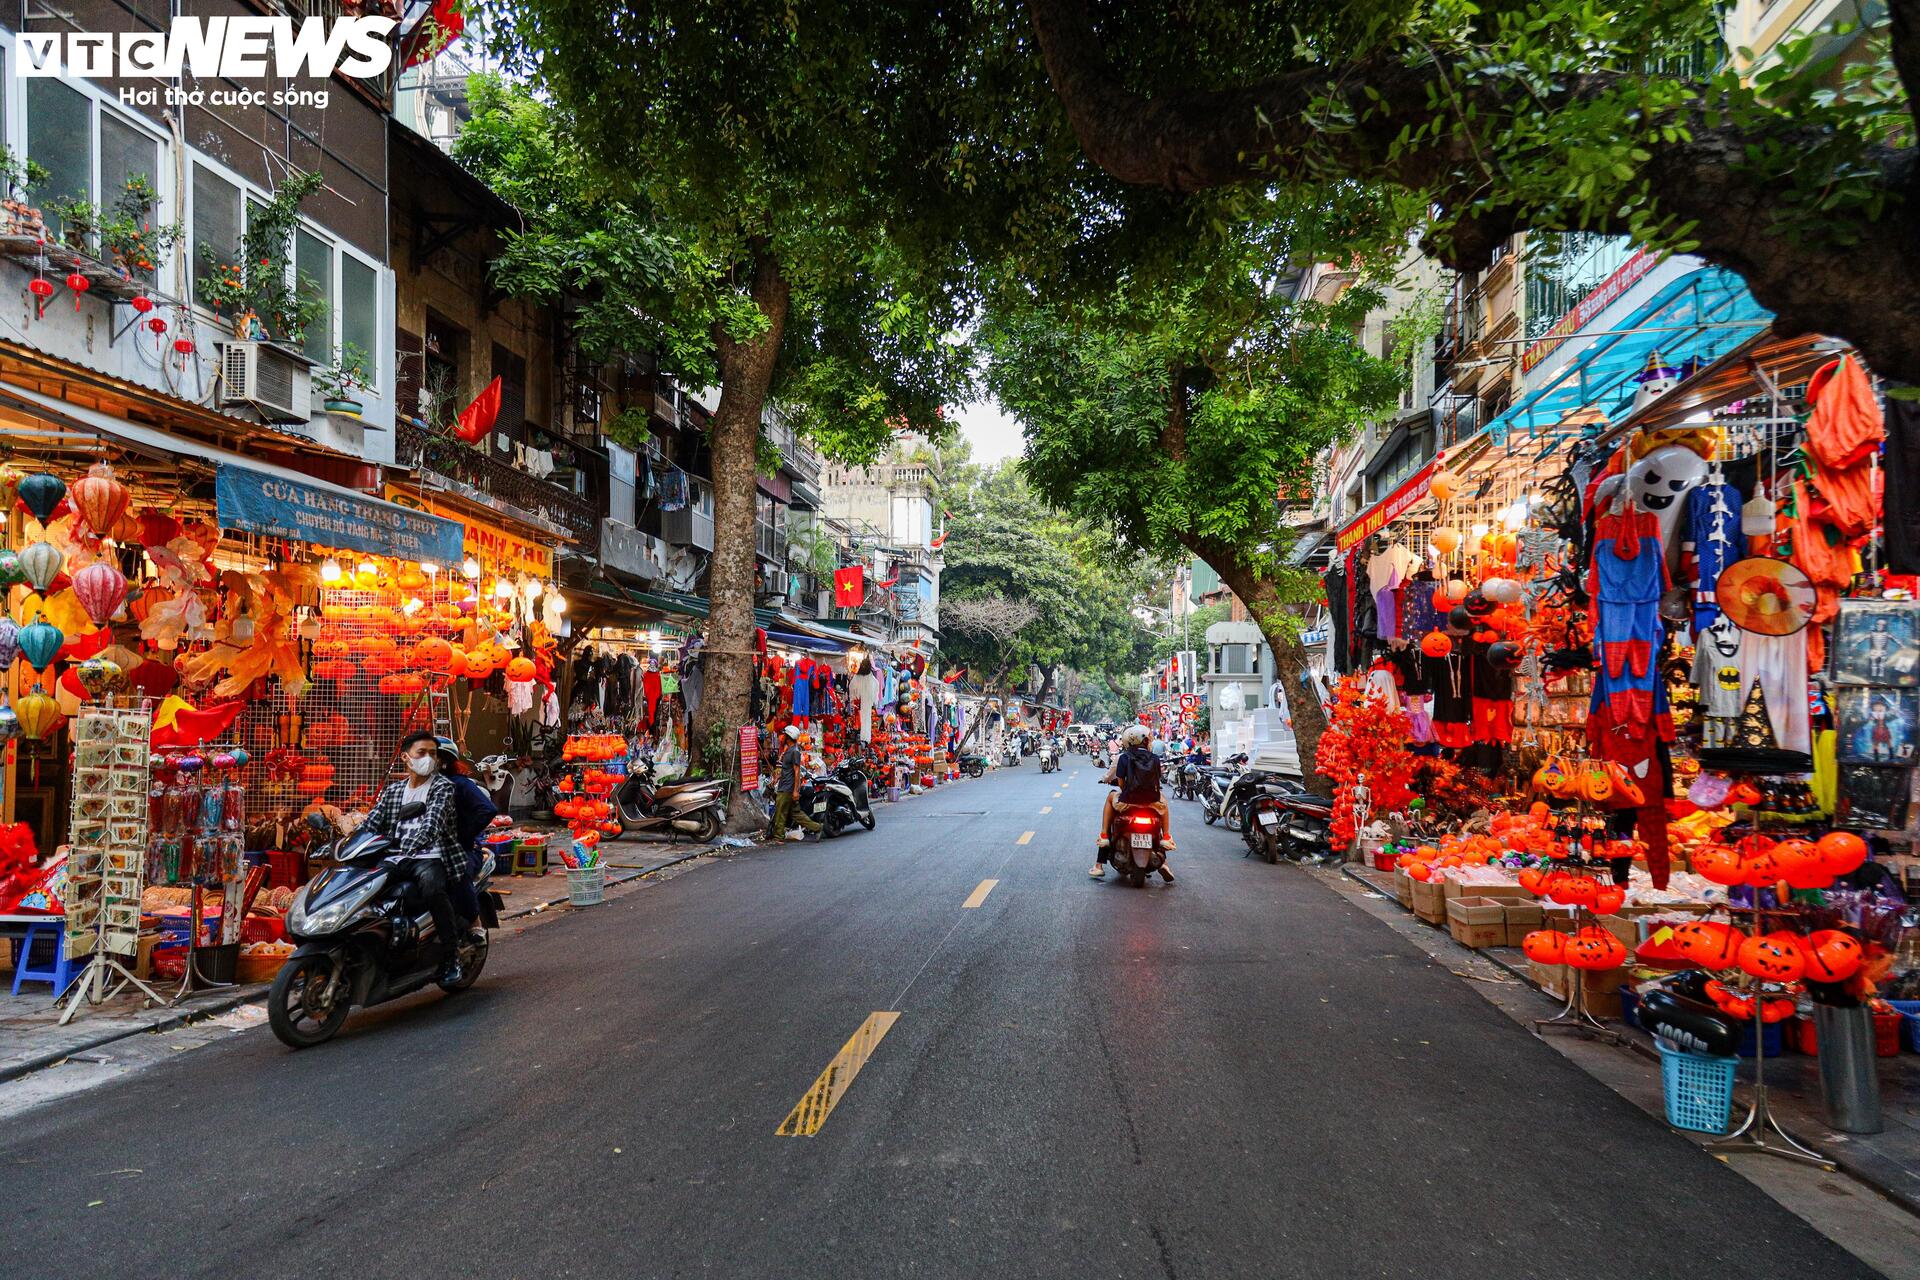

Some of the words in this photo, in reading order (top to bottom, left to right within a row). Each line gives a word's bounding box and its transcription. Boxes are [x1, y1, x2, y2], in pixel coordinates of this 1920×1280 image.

[262, 480, 300, 504] CỬA
[1339, 523, 1364, 552] THANH
[1656, 1022, 1693, 1046] 1000
